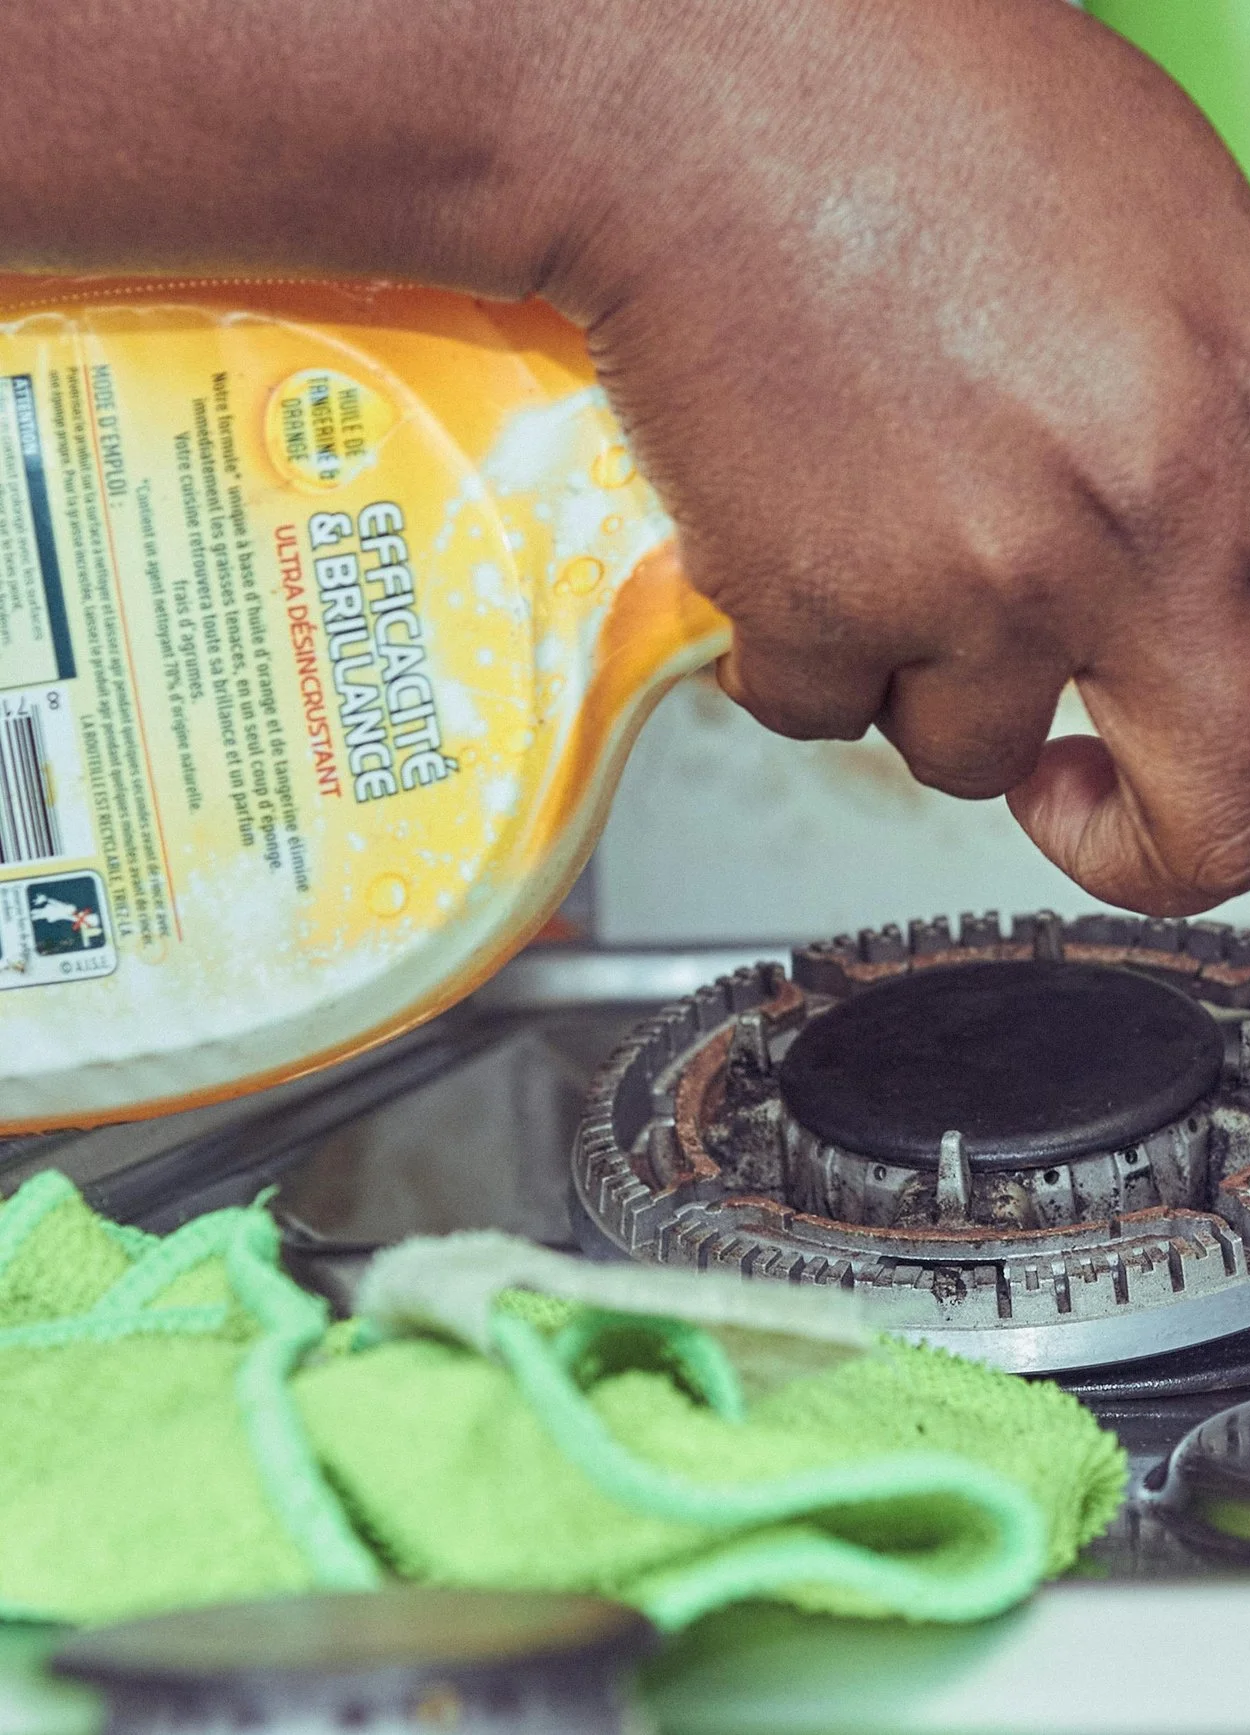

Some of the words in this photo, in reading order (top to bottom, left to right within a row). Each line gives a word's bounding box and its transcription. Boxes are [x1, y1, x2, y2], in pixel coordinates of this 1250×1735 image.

[90, 363, 115, 411] MODE
[211, 371, 229, 411] Notre
[13, 377, 39, 455] ATTENTION
[281, 397, 307, 462] ORANGE
[305, 375, 337, 462] TANGERINE
[336, 387, 363, 433] HUILE
[97, 415, 127, 496] D'EMPLOI
[172, 431, 195, 470] Votre
[343, 436, 366, 457] DE
[318, 468, 338, 481] &
[84, 491, 96, 503] la
[179, 473, 203, 528] cuisine
[224, 484, 250, 536] unique
[209, 515, 227, 538] les
[304, 507, 355, 550] &
[143, 540, 157, 556] un
[272, 523, 307, 600] ULTRA
[143, 558, 164, 595] agent
[187, 531, 216, 610] retrouvera
[210, 541, 238, 606] graisses
[236, 551, 258, 588] base
[101, 603, 114, 614] et
[171, 578, 194, 614] frais
[149, 597, 175, 658] nettoyant
[201, 613, 223, 653] toute
[243, 590, 268, 645] d'huile
[222, 609, 250, 675] tenaces,
[353, 499, 460, 791] EFFICACITÉ
[209, 657, 223, 675] sa
[250, 647, 280, 716] d'orange
[312, 552, 398, 803] BRILLANCE
[47, 691, 59, 710] 8
[235, 678, 250, 697] en
[286, 604, 341, 800] DÉSINCRUSTANT
[79, 714, 94, 730] LA
[212, 678, 240, 746] brillance
[239, 701, 254, 720] un
[266, 718, 283, 734] et
[225, 749, 242, 765] et
[244, 723, 264, 756] seul
[269, 737, 287, 756] de
[82, 730, 105, 789] BOUTEILLE
[228, 769, 243, 788] un
[247, 759, 268, 797] coup
[92, 790, 109, 811] EST
[270, 760, 300, 833] tangerine
[228, 791, 258, 847] parfum
[141, 831, 157, 861] avant
[129, 866, 145, 896] avant
[146, 862, 159, 876] de
[135, 897, 148, 911] de
